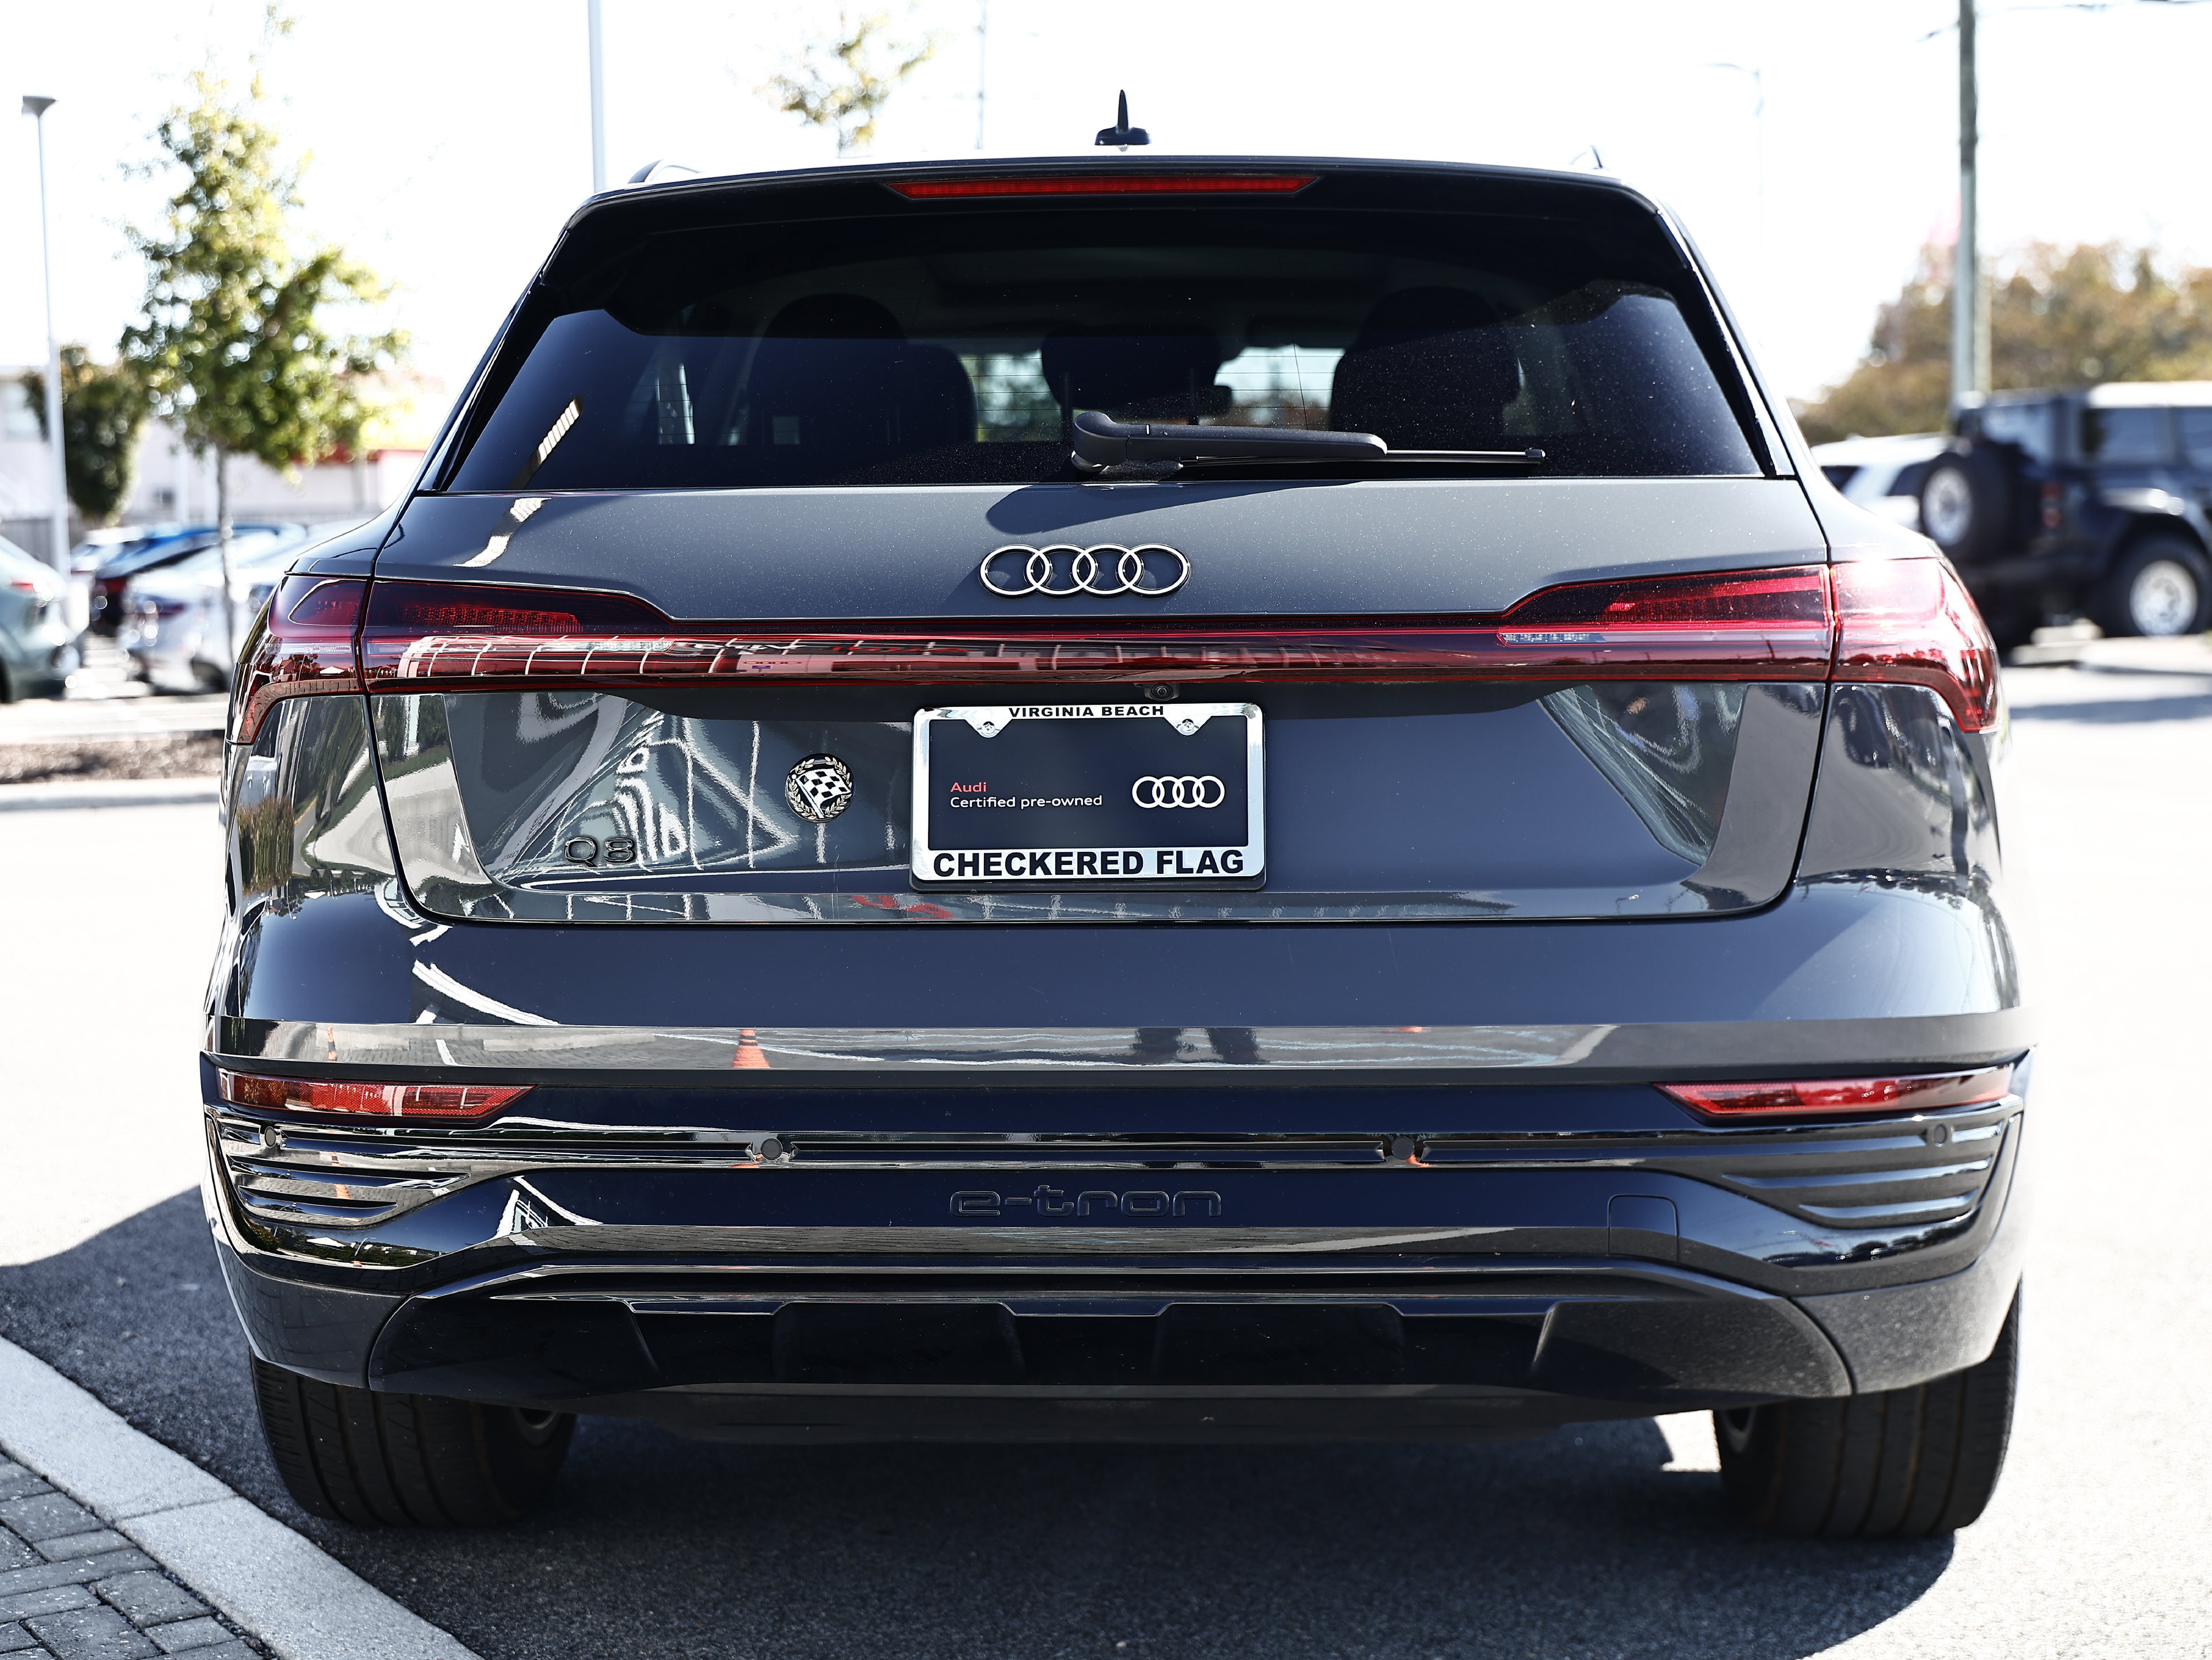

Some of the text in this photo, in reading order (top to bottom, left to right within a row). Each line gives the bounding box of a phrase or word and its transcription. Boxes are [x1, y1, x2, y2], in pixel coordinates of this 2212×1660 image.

[1009, 706, 1164, 717] VIRGINIA BEACH
[950, 782, 987, 793] Audi
[950, 795, 1103, 809] Certified pre-owned
[565, 836, 635, 867] Q8
[933, 850, 1243, 876] CHECKERED FLAG
[950, 1185, 1222, 1217] e-tron
